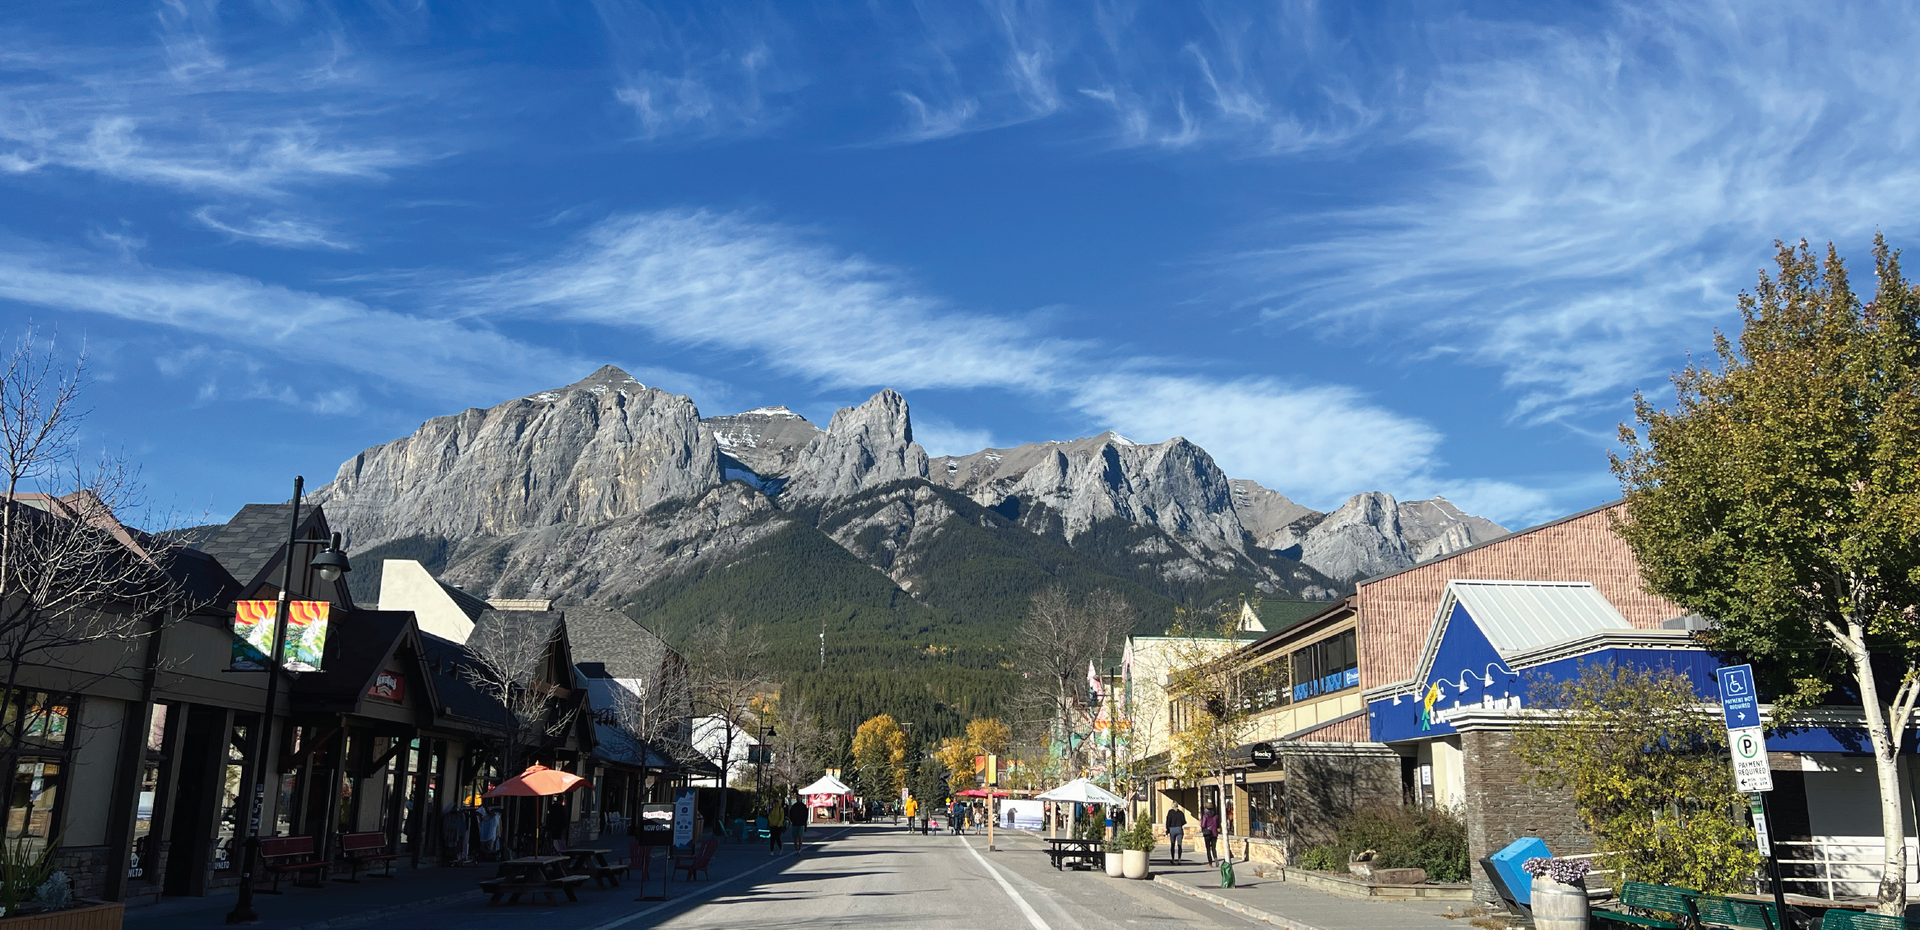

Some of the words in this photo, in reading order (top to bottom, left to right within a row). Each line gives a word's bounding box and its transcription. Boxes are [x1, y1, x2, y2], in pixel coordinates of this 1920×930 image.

[1729, 702, 1750, 710] REQUIRED
[1743, 739, 1752, 754] P
[1254, 750, 1272, 758] Rocky
[1738, 760, 1763, 768] PAYMENT
[1738, 767, 1766, 776] REQUIRED
